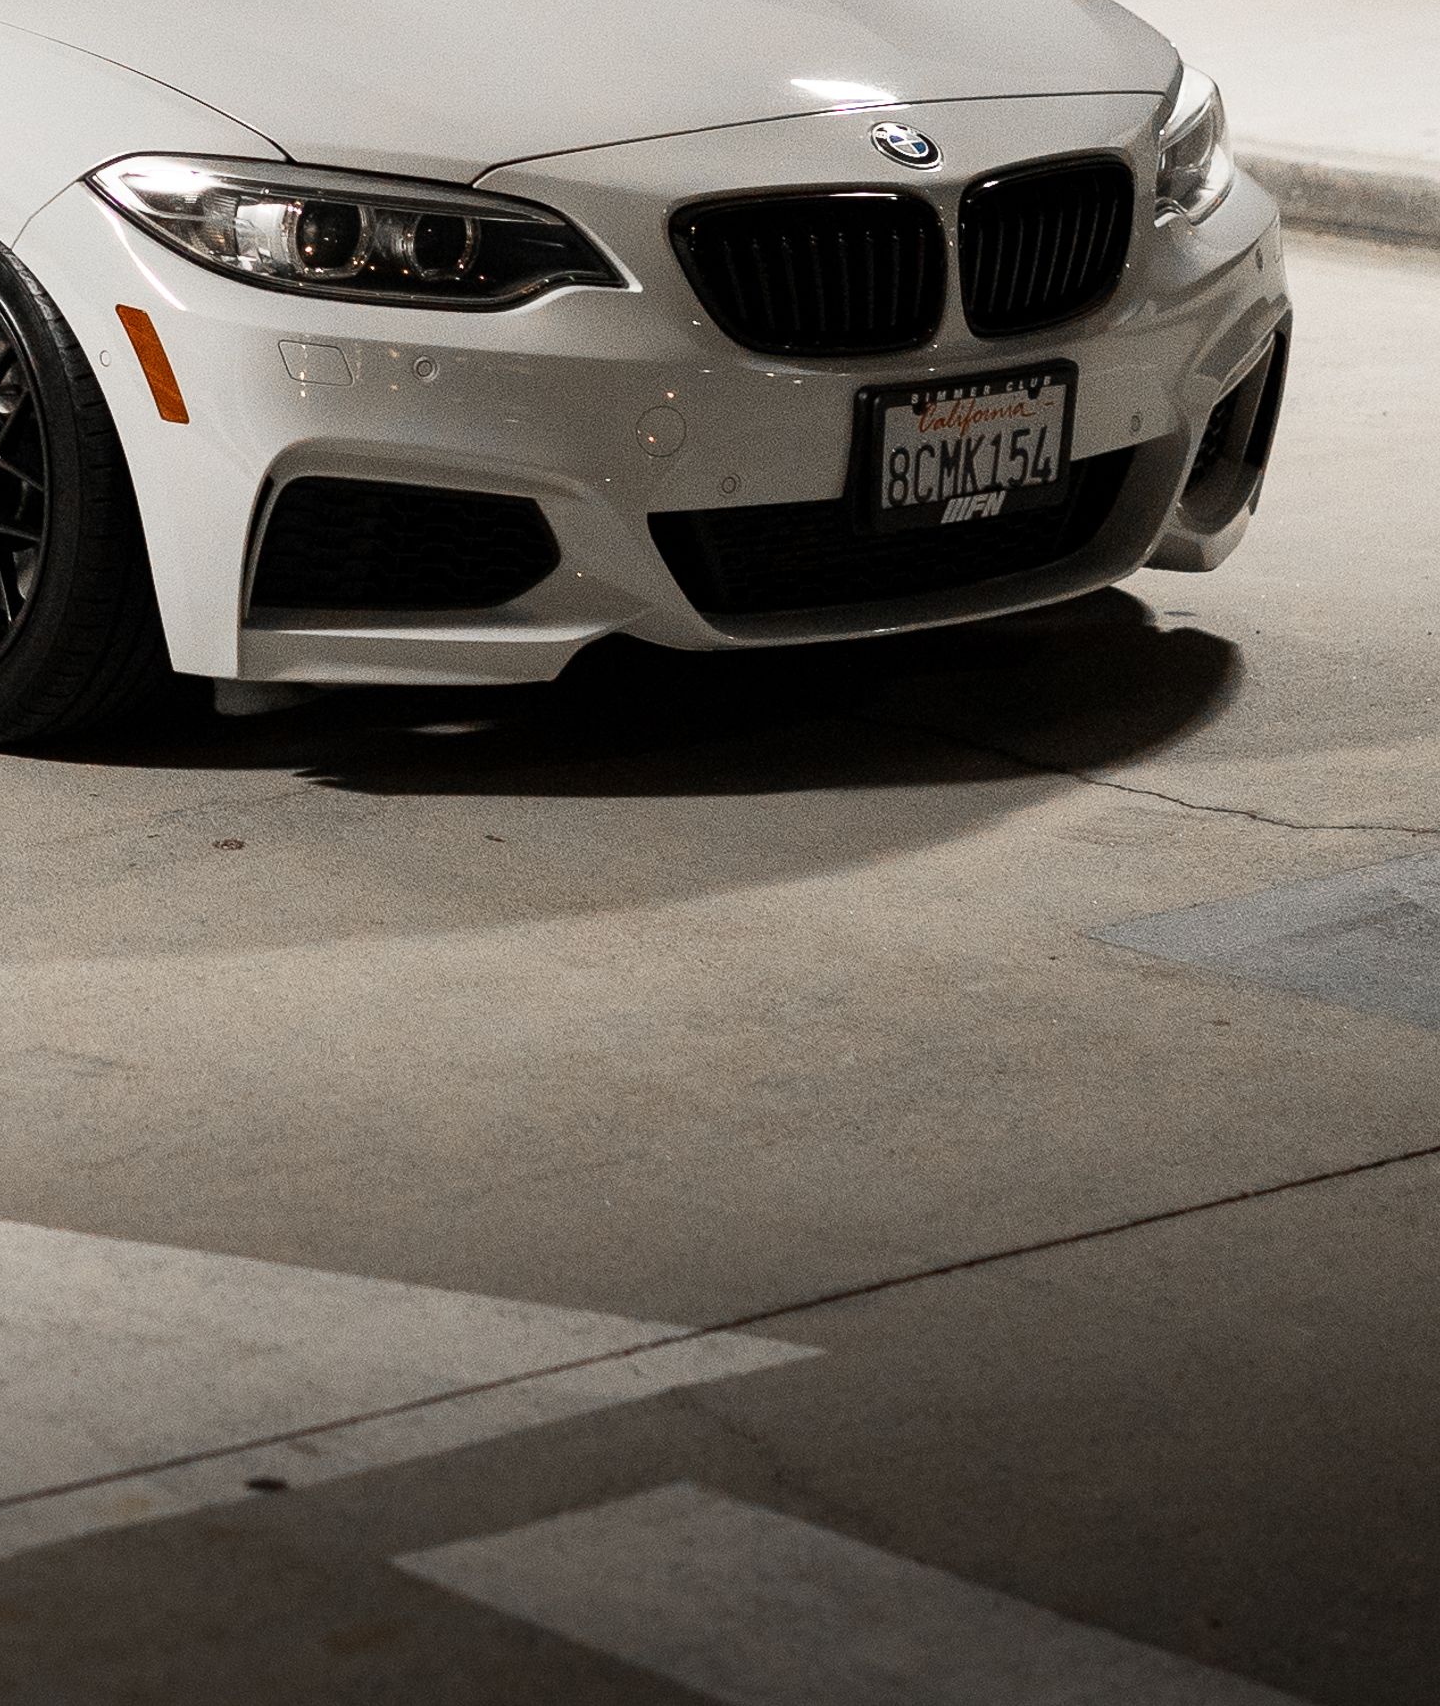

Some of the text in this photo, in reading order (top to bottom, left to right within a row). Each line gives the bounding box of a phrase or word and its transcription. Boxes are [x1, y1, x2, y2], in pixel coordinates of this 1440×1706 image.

[1006, 375, 1052, 392] CLUB
[919, 398, 1035, 437] California
[890, 426, 1052, 507] 8CMK154
